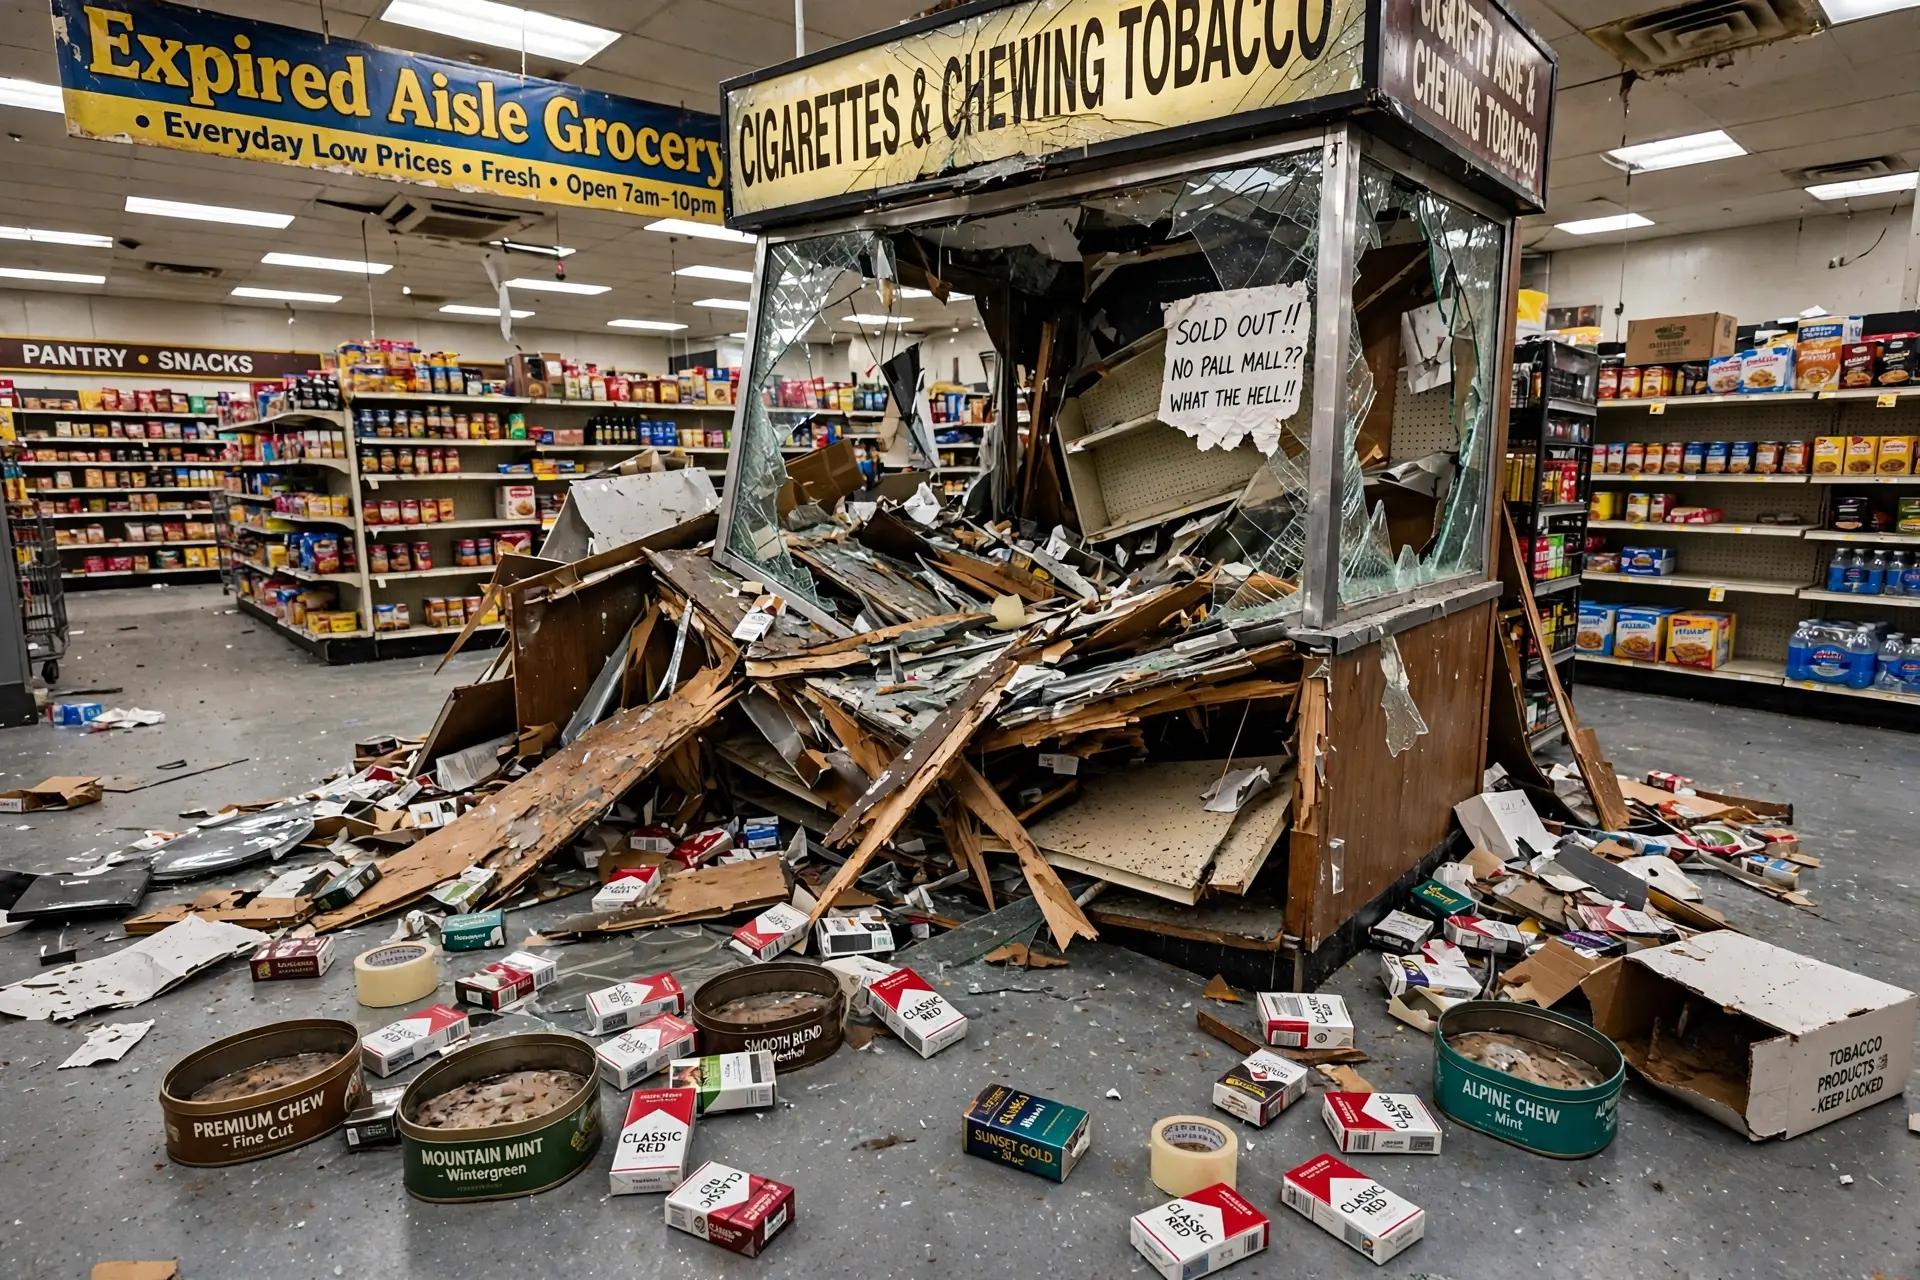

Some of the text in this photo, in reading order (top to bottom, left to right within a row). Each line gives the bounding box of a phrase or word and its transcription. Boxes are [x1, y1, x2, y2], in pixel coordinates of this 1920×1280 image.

[83, 5, 723, 188] Expired Aisle Grocery
[739, 0, 1332, 187] CIGARETTES & CHEWING TOBACCO
[1526, 66, 1536, 115] &
[1413, 39, 1538, 178] CHEWING TOBACCO
[164, 111, 303, 160] Everyday
[313, 134, 367, 163] Low
[376, 144, 452, 175] Prices
[482, 160, 540, 188] Fresh
[567, 174, 617, 201] Open
[1175, 302, 1302, 346] SOLD OUT!!
[23, 344, 254, 374] PANTRY SNACKS
[1172, 346, 1304, 381] NO PALL MALL??
[1170, 380, 1297, 413] WHAT THE HELL!!
[903, 996, 944, 1020] CLASSIC
[920, 1007, 943, 1022] RED
[744, 1024, 823, 1053] SMOOTH BLEND
[1829, 1036, 1883, 1067] TOBACCO
[1818, 1059, 1875, 1093] PRODUCTS
[1846, 1076, 1884, 1102] LOCKED
[193, 1090, 325, 1138] PREMIUM CHEW
[1462, 1078, 1512, 1110] ALPINE
[1514, 1098, 1561, 1125] CHEW
[1494, 1110, 1524, 1131] Mint
[233, 1134, 264, 1149] Fine
[268, 1123, 294, 1140] Cut
[622, 1131, 682, 1144] CLASSIC
[636, 1142, 666, 1153] RED
[975, 1129, 1053, 1163] SUNSET GOLD
[421, 1138, 544, 1166] MOUNTAIN MINT
[446, 1164, 527, 1181] Wintergreen
[1340, 1185, 1386, 1214] CLASSIC
[1362, 1198, 1387, 1216] RED
[1164, 1216, 1190, 1237] RED
[1167, 1203, 1214, 1244] CLASSIC
